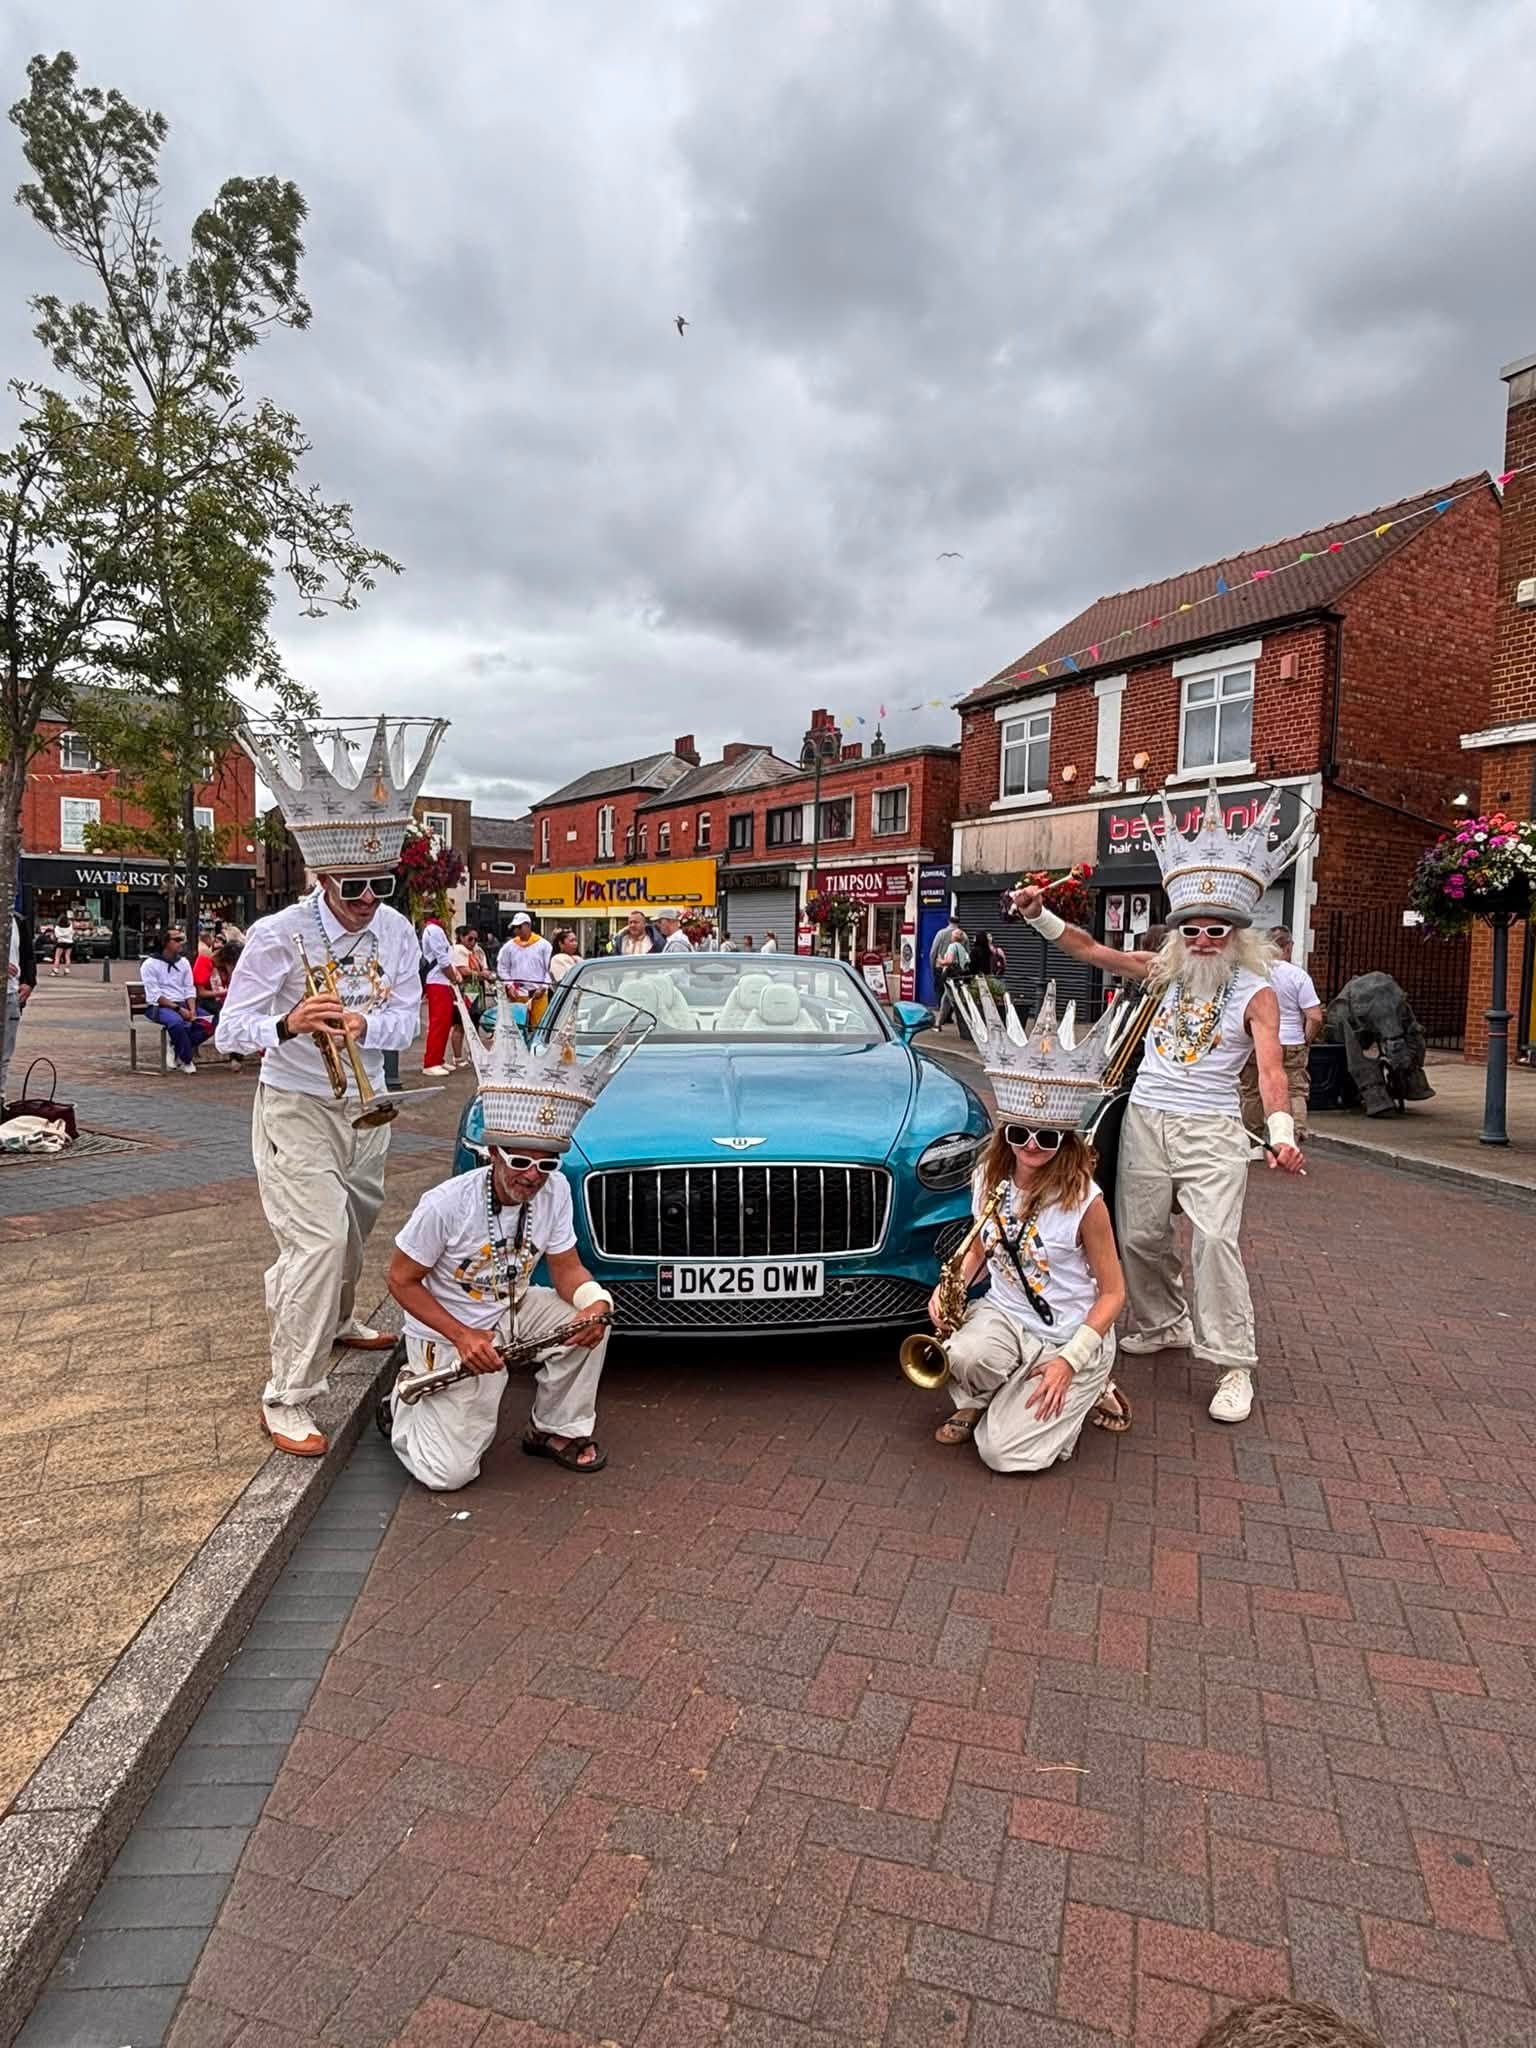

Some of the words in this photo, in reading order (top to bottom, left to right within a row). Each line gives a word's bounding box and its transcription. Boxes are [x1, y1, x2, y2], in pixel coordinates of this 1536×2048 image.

[1108, 842, 1132, 855] hair
[825, 872, 884, 892] TIMPSON
[679, 1267, 754, 1294] DK26
[763, 1265, 818, 1292] OWW
[661, 1284, 673, 1294] UK
